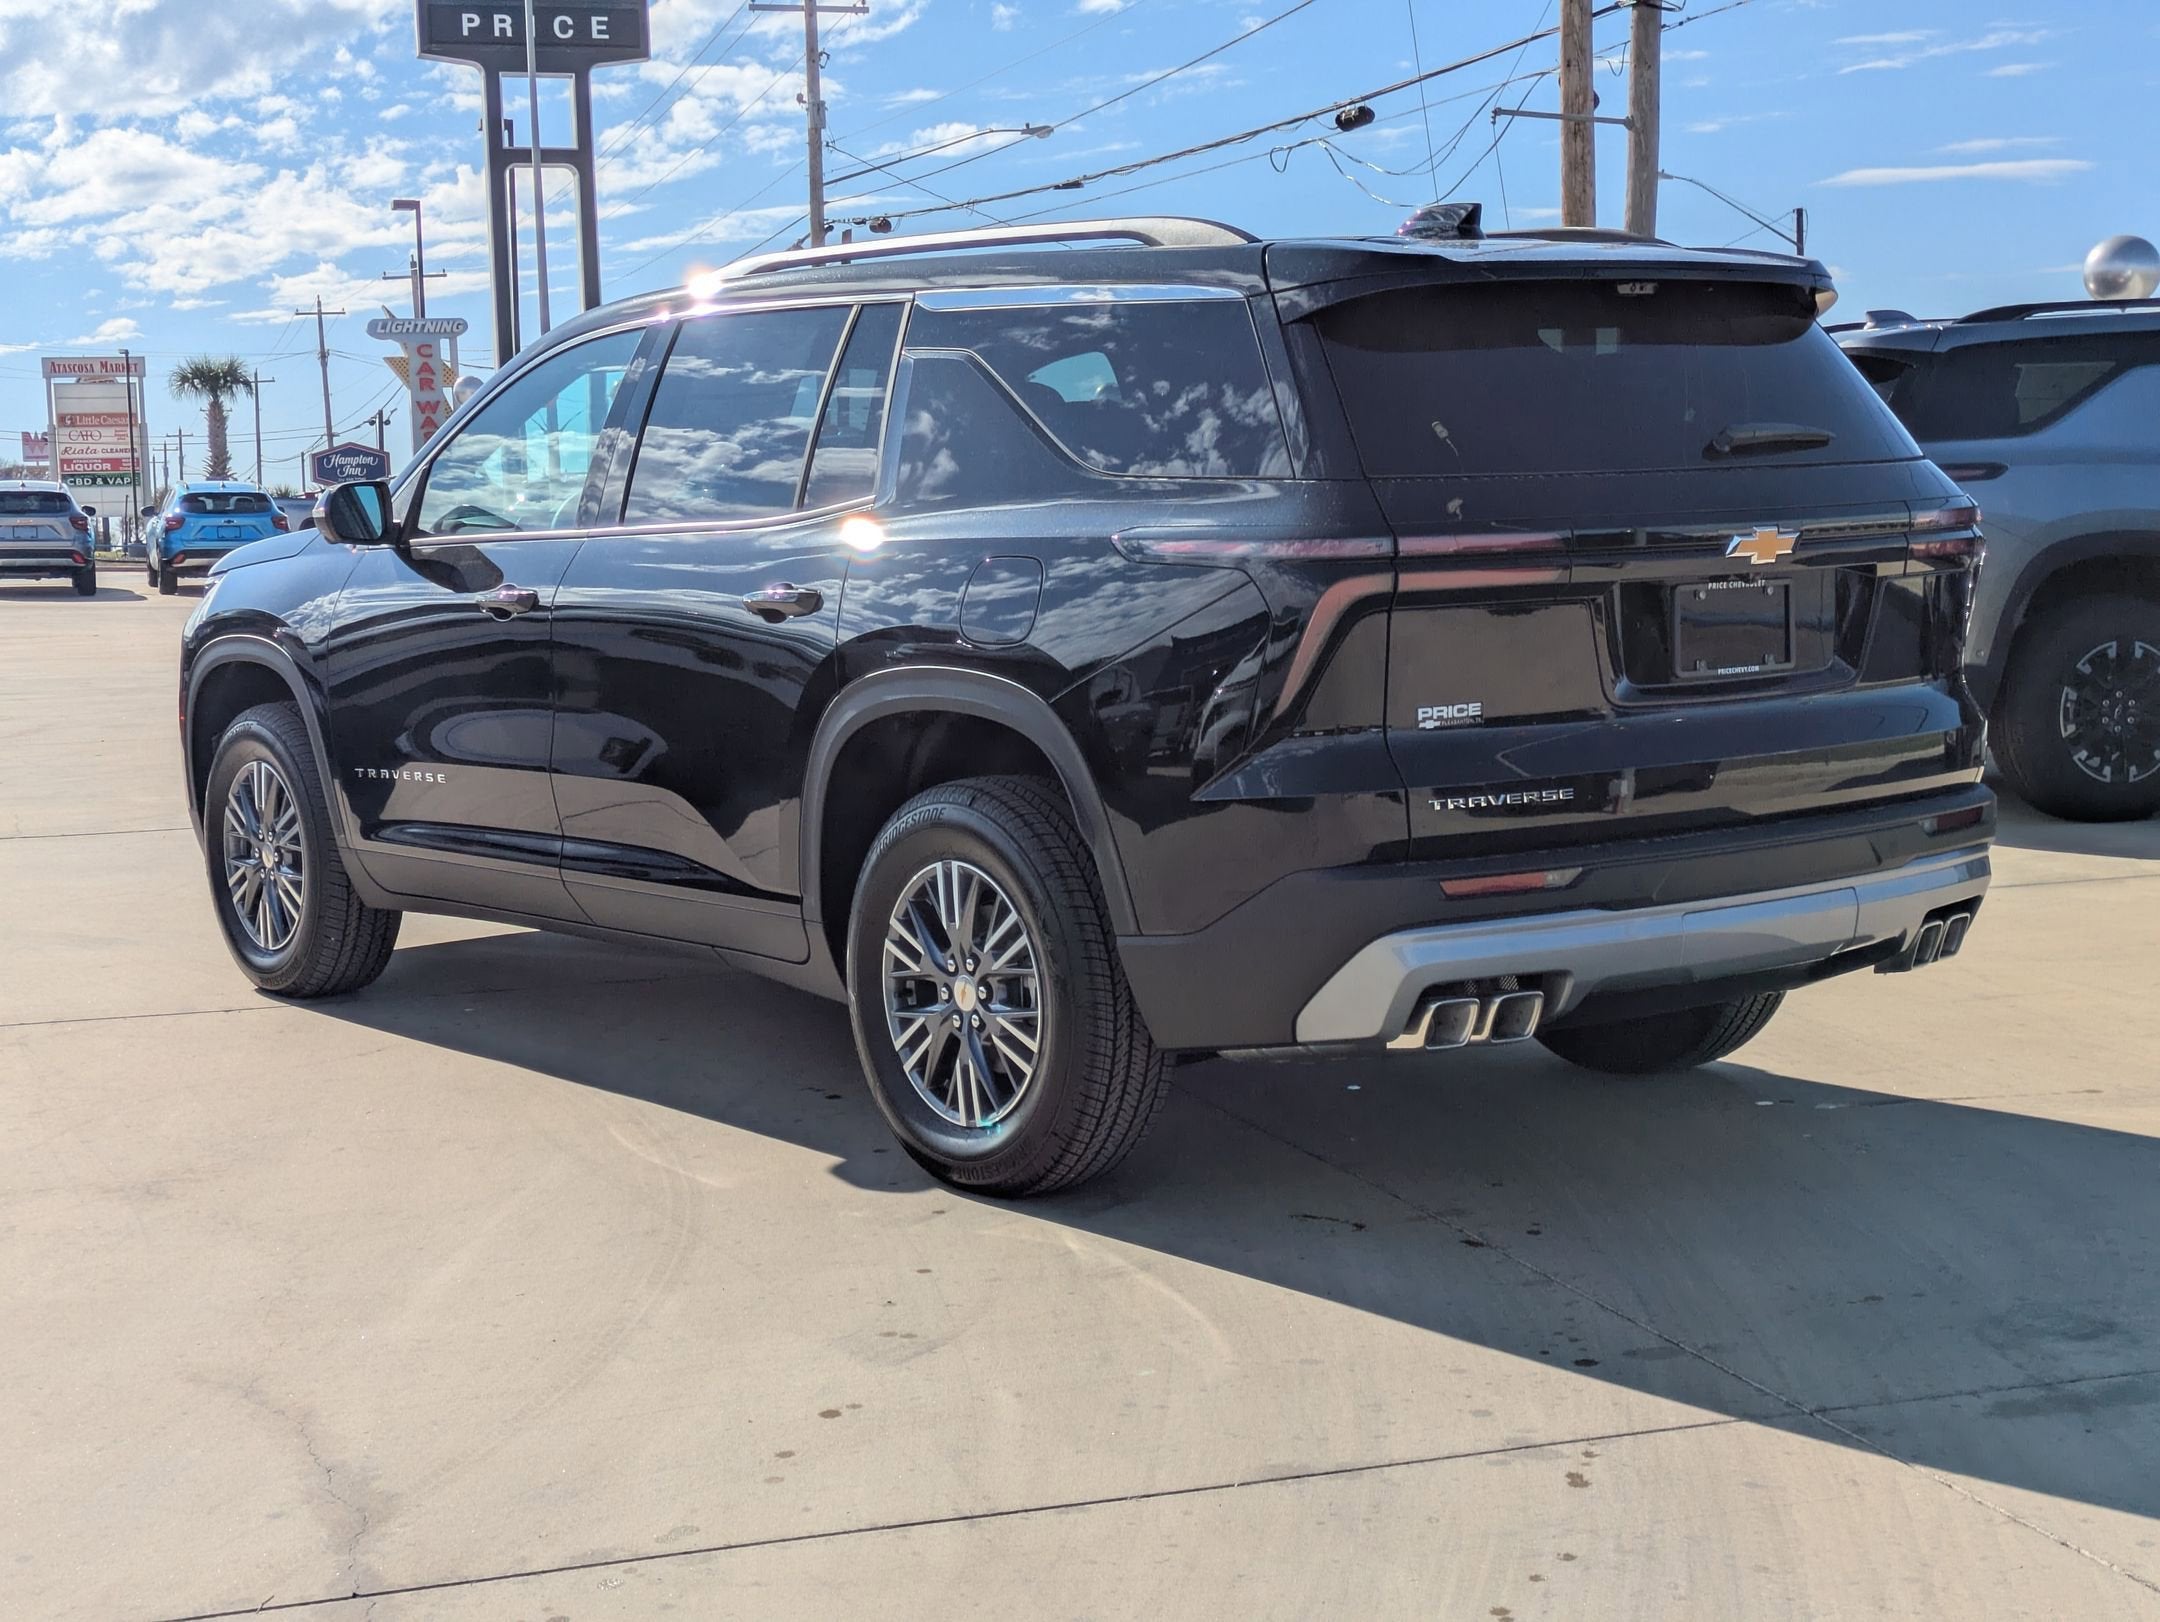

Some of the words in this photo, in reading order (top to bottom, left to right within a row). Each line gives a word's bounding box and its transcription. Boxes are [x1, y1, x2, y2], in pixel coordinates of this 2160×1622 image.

[376, 320, 465, 334] LIGHTNING
[416, 344, 436, 392] CAR
[76, 415, 100, 425] Little
[101, 415, 136, 426] Caesas
[68, 429, 102, 441] CATO
[61, 446, 98, 455] Riata
[63, 463, 112, 472] LIQUOR
[324, 454, 379, 468] Hampton
[337, 465, 367, 478] Inn
[66, 478, 92, 486] CBD
[96, 477, 104, 486] &
[1708, 582, 1728, 590] PRICE
[1418, 702, 1482, 721] PRICE
[354, 768, 447, 784] TRAVERSE
[1428, 788, 1574, 811] TRAVERSE
